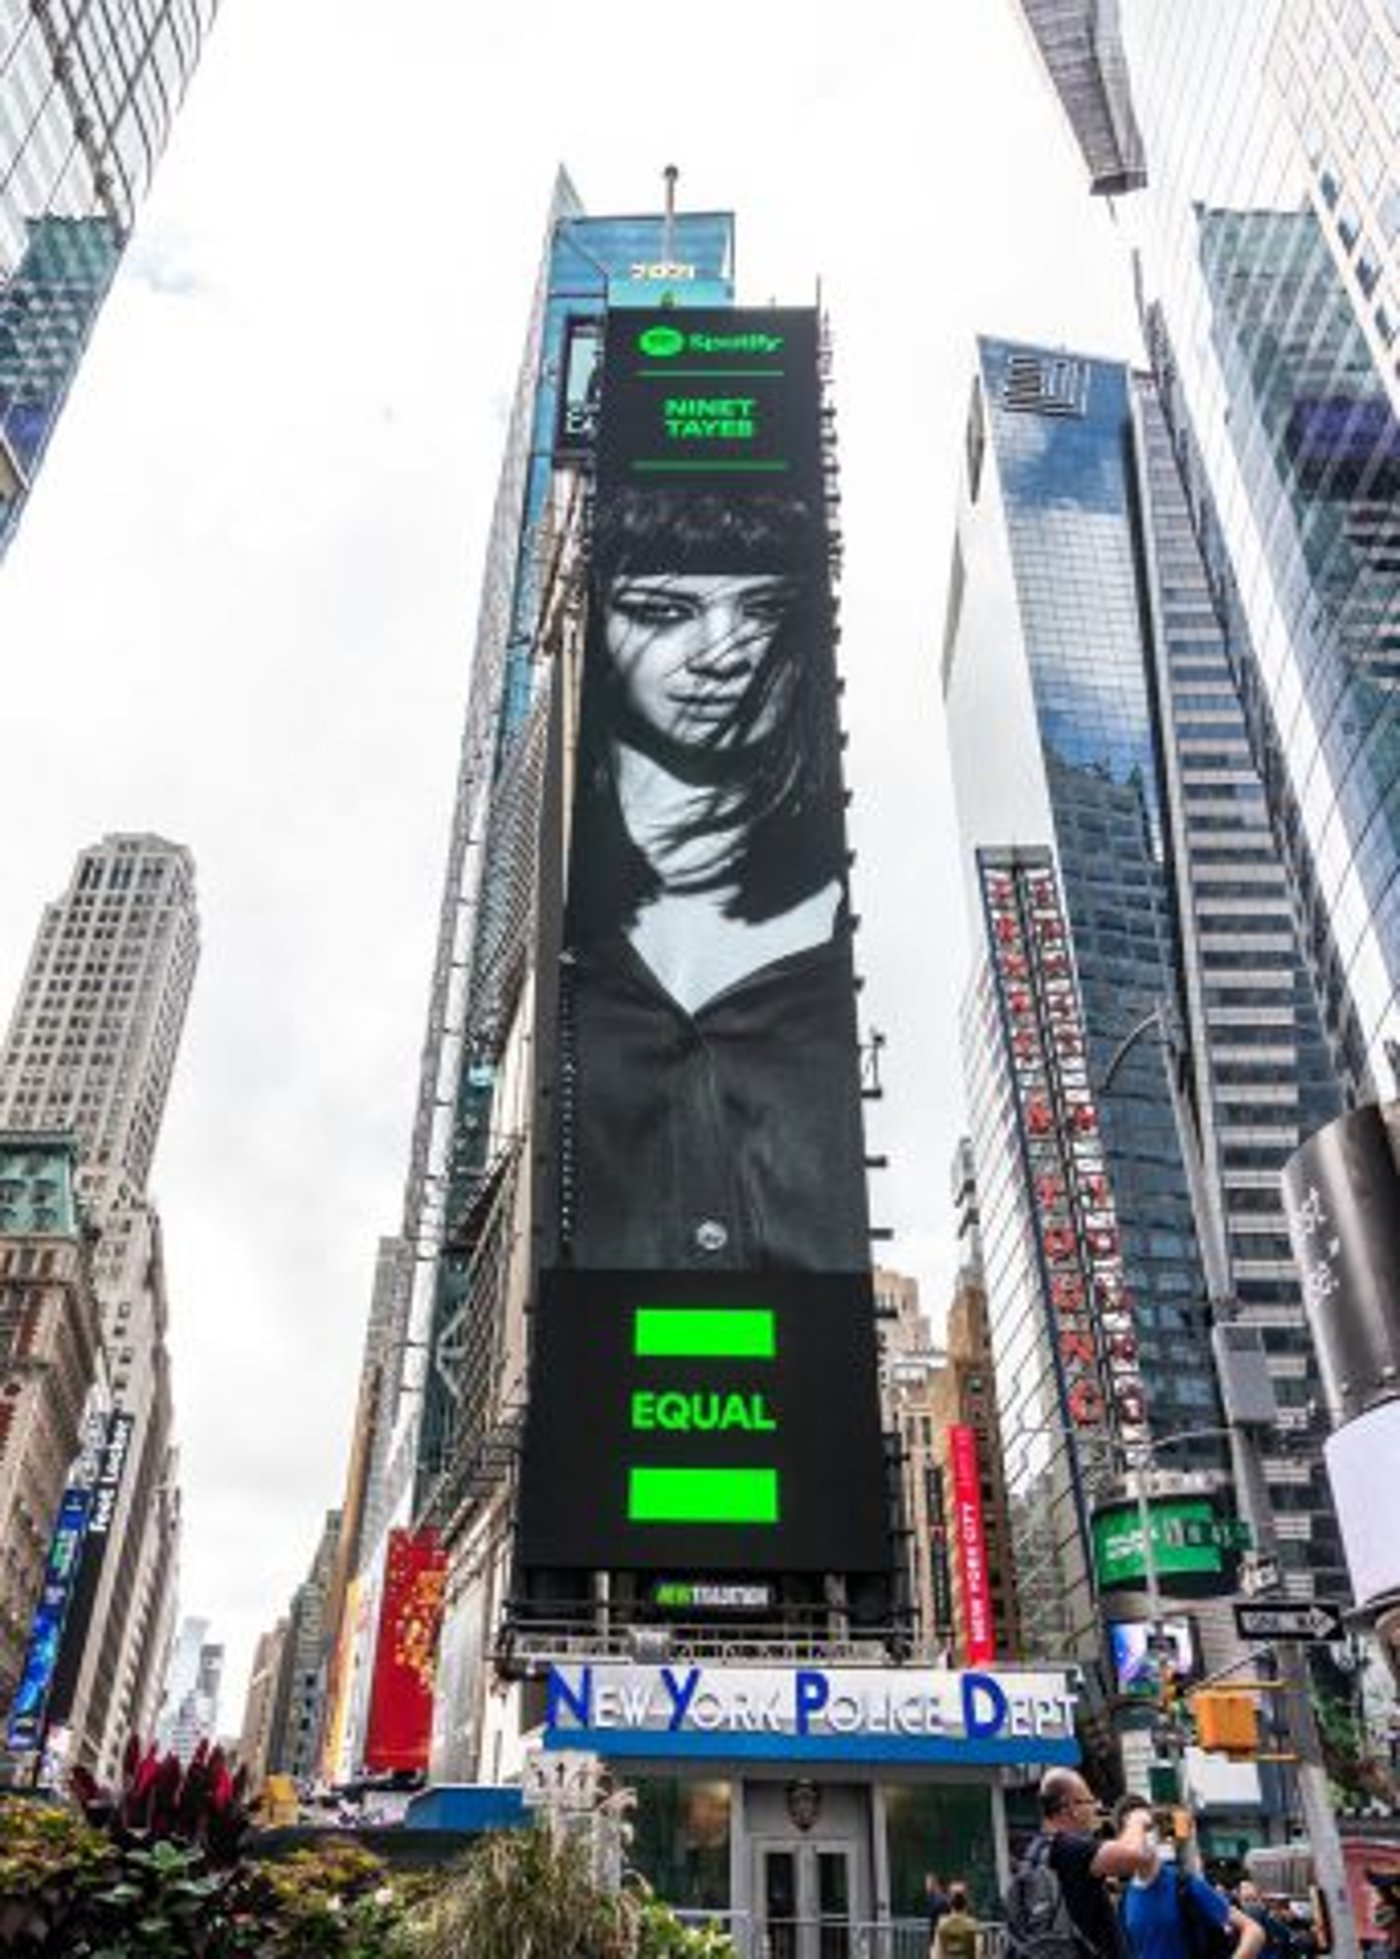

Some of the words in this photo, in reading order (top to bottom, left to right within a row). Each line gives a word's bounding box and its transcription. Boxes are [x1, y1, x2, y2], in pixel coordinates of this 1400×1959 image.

[689, 333, 783, 354] Spotify
[665, 399, 753, 417] NINET
[631, 1391, 777, 1431] EQUAL
[545, 1663, 651, 1729] NEW
[660, 1667, 782, 1732] YORK
[795, 1671, 942, 1735] POLICE
[960, 1672, 1080, 1738] DEPT
